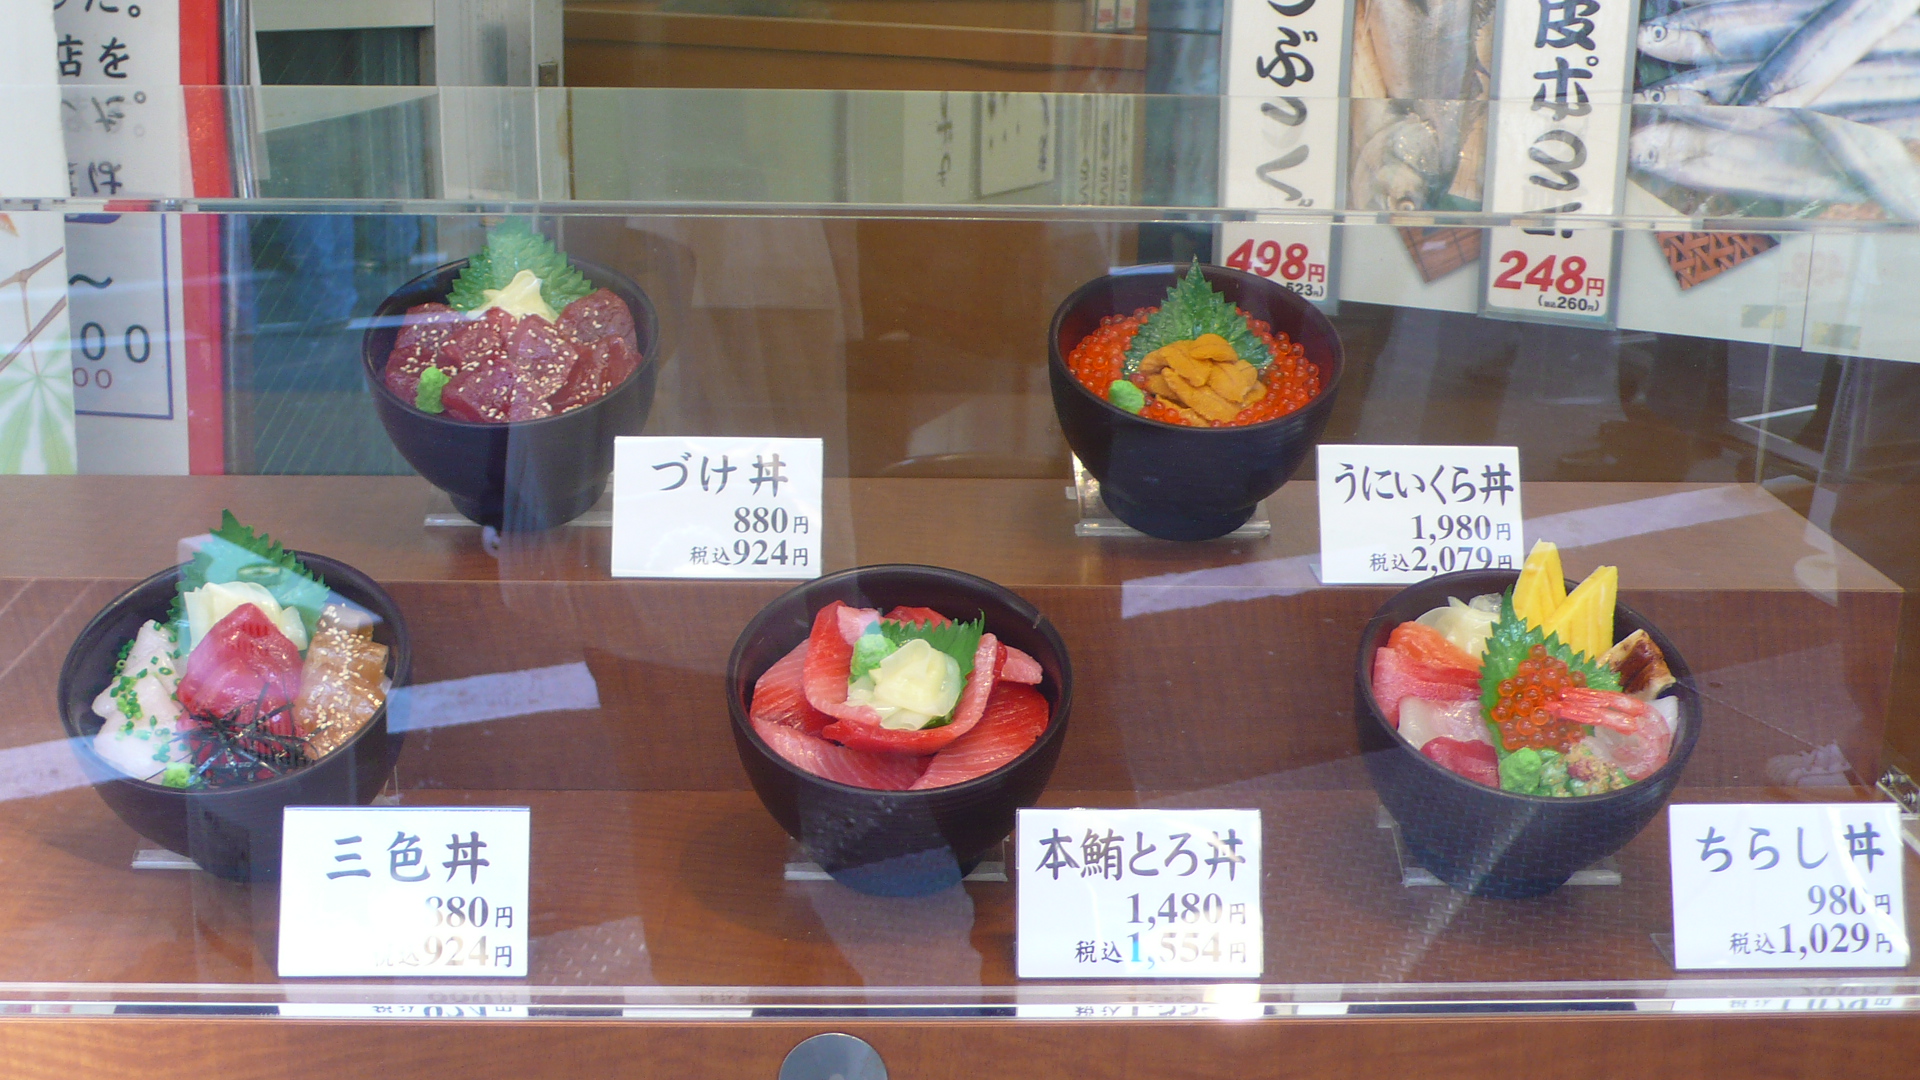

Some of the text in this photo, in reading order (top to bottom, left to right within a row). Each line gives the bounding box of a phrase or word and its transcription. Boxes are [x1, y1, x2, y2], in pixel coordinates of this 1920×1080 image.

[1226, 239, 1325, 282] 498円
[1493, 250, 1605, 297] 248円
[651, 452, 788, 498] づけ丼
[1335, 463, 1514, 506] うにいくら丼
[734, 507, 809, 534] 880円
[1411, 514, 1511, 545] 1,980円
[326, 831, 490, 885] 三色丼
[1035, 828, 1246, 881] 本鮪とろ丼
[1696, 822, 1885, 873] ちらし丼
[1127, 893, 1246, 930] 1,480円
